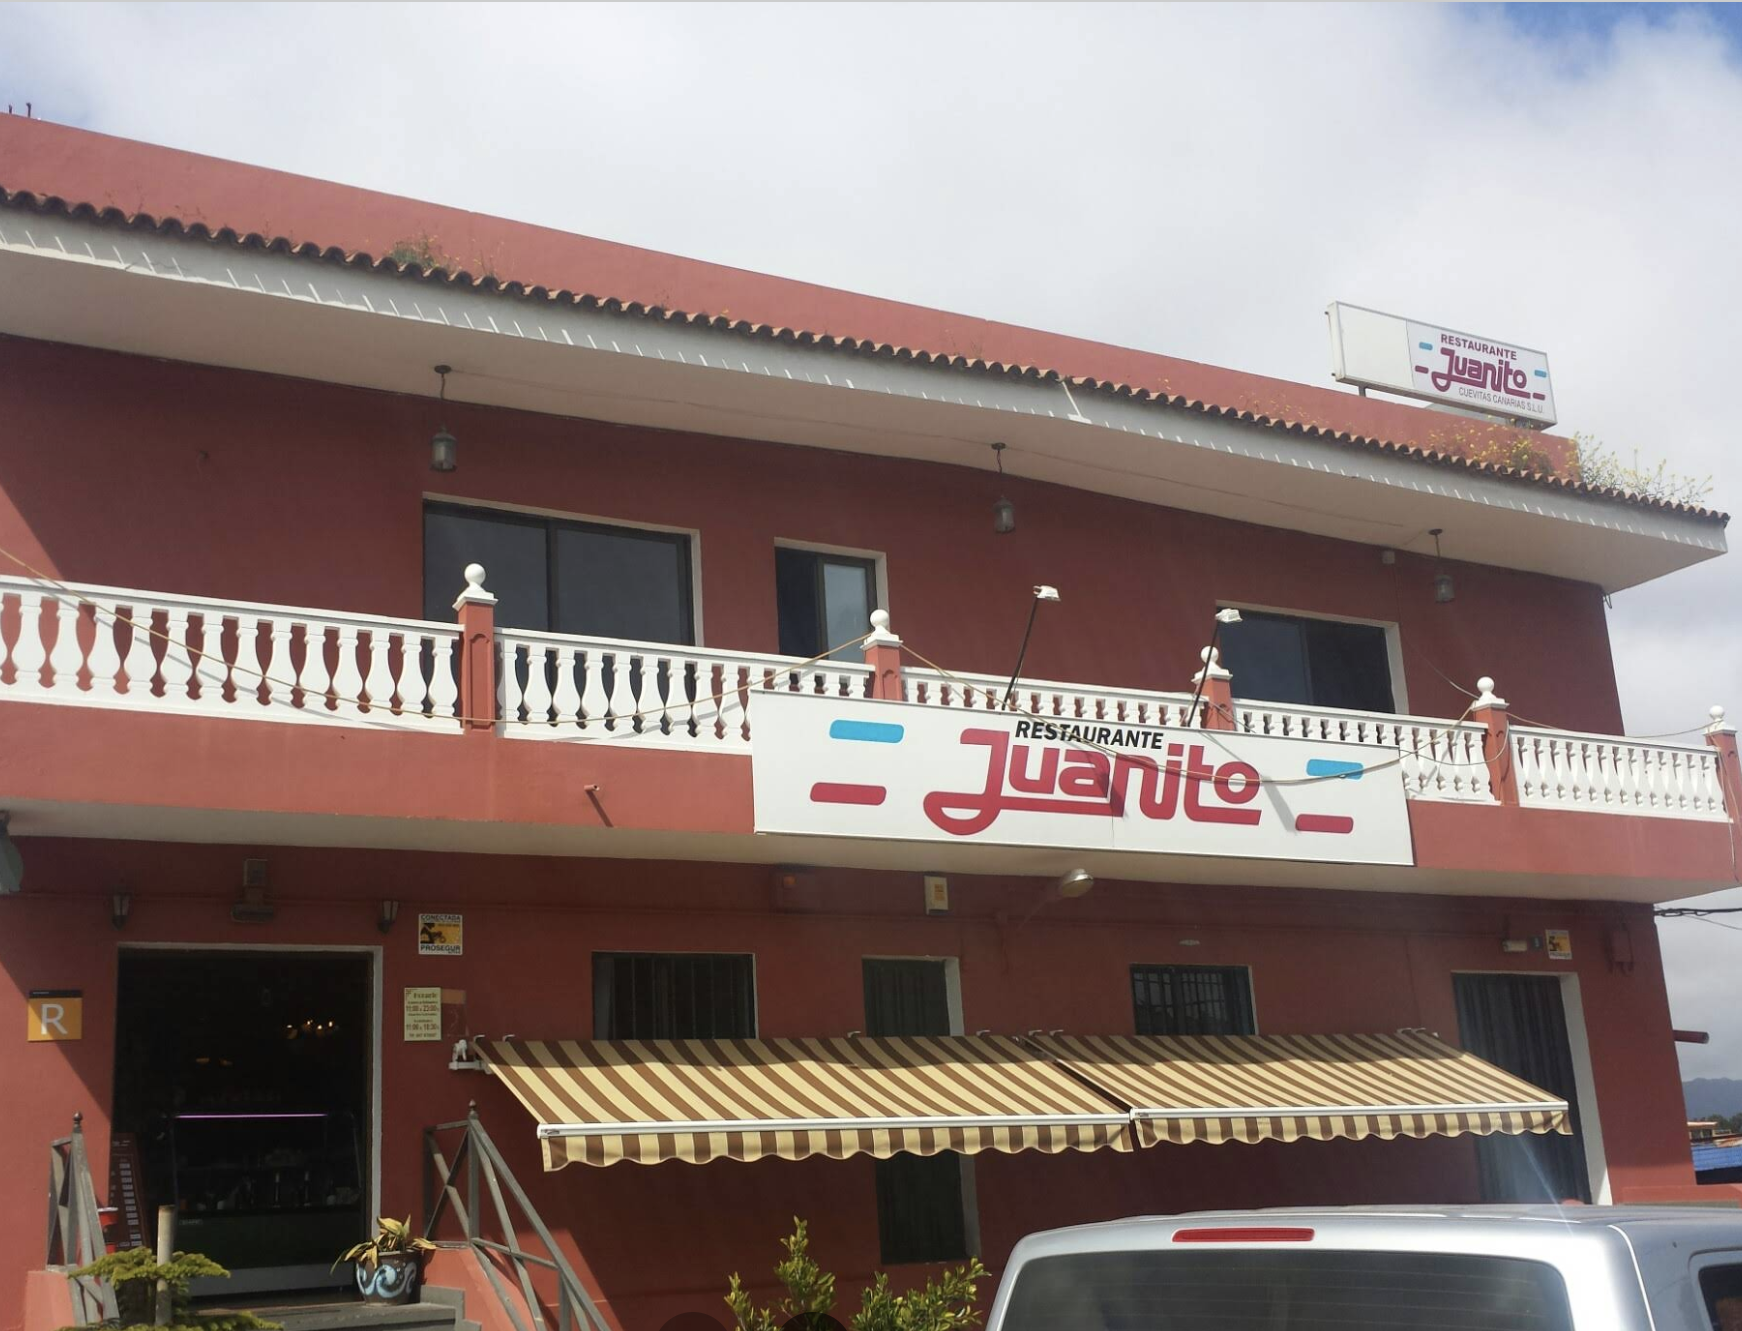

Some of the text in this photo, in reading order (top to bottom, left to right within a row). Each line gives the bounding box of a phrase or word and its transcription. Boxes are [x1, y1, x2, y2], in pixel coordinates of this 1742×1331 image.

[1440, 333, 1518, 361] RESTAURANTE
[1431, 347, 1531, 399] Juanito
[1458, 386, 1492, 403] CUEVITAS
[1492, 394, 1526, 410] CANARIAS
[1015, 720, 1165, 750] RESTAURANTE
[923, 728, 1262, 836] Juanito
[420, 944, 461, 952] PROSEGUR
[41, 1003, 68, 1035] R
